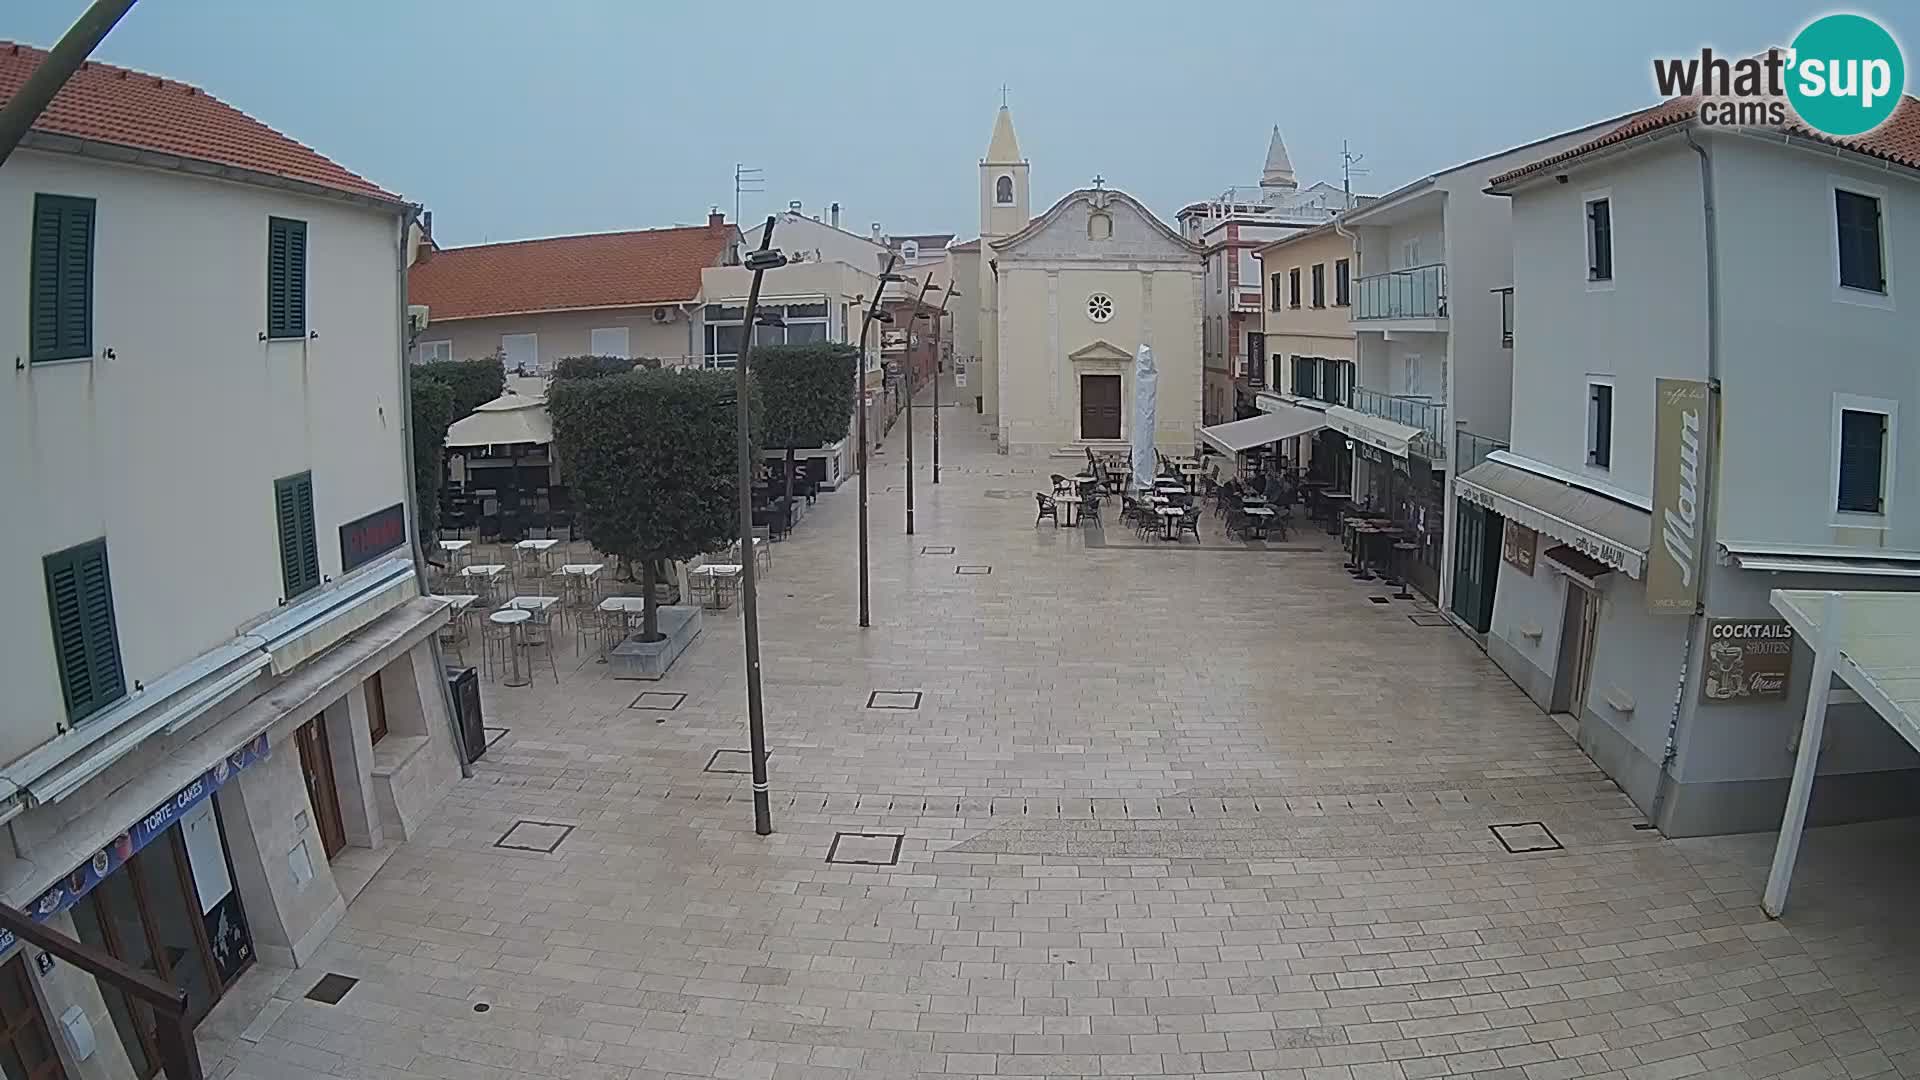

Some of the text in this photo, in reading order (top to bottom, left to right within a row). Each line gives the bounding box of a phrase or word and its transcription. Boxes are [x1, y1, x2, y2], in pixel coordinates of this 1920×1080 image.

[1712, 624, 1792, 638] COCKTAILS
[144, 803, 173, 833] TORTE
[177, 780, 203, 808] CAKES
